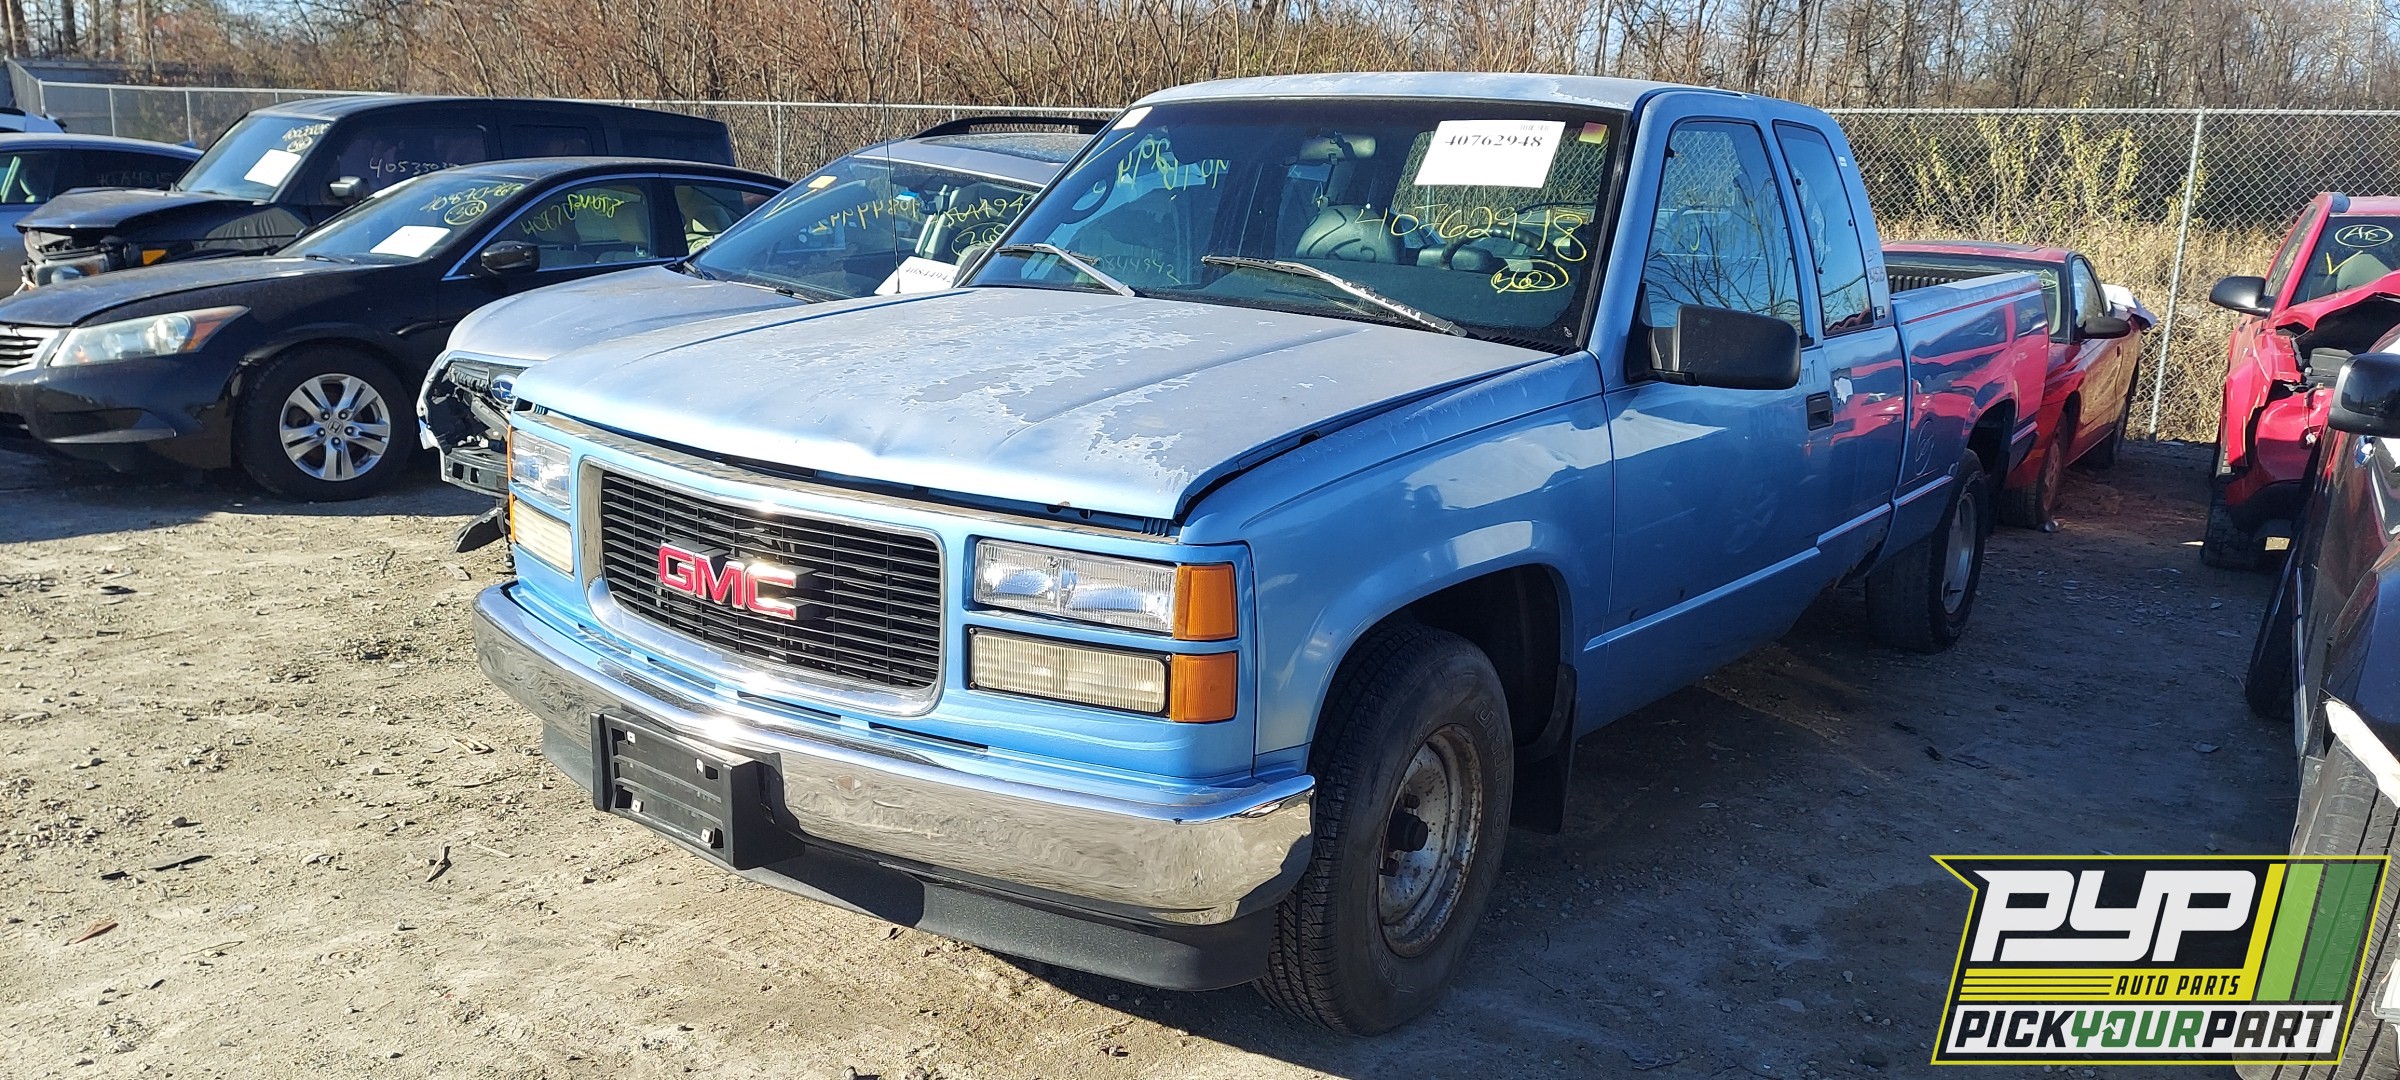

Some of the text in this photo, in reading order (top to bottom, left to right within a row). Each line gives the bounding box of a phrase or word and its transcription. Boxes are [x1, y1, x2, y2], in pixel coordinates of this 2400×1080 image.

[1444, 134, 1544, 147] 40762948
[1355, 203, 1588, 262] 40762948
[658, 543, 797, 621] GMC
